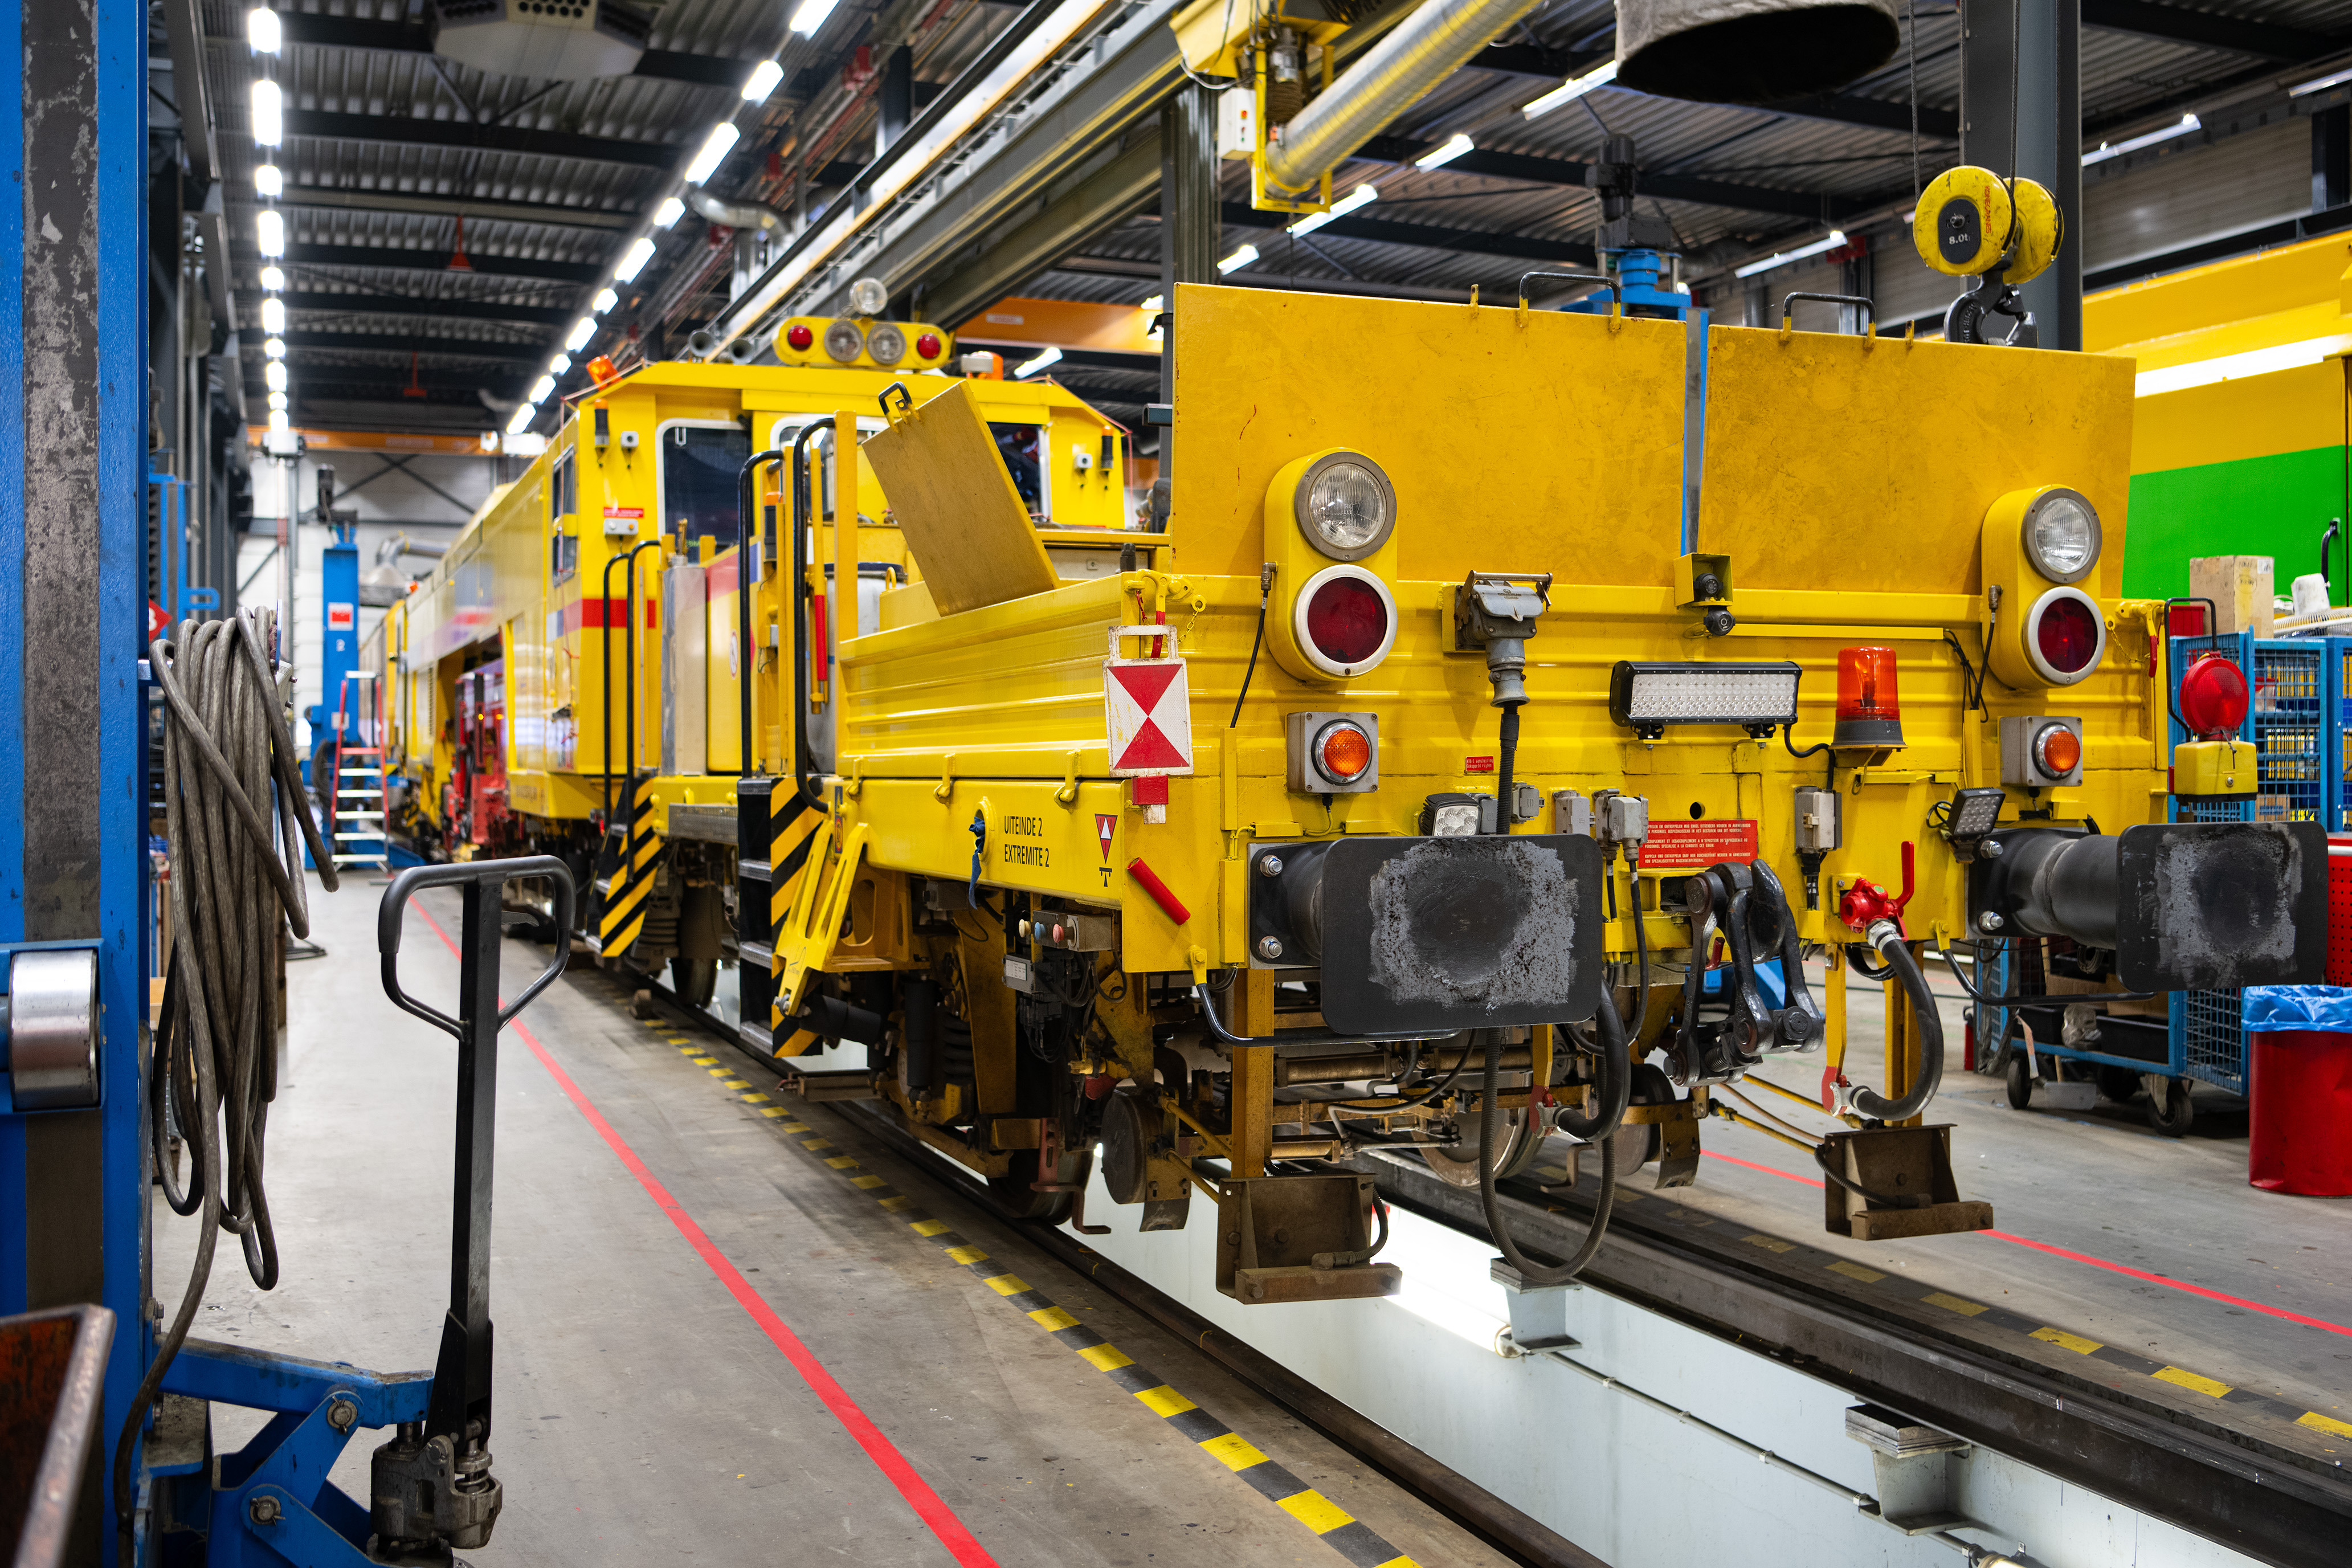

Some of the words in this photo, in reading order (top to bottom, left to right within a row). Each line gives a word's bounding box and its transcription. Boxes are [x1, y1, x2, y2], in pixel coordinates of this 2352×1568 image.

[1949, 233, 1969, 244] 8.0t
[1004, 815, 1036, 836] UITEINDE
[1038, 817, 1042, 836] 2
[1004, 844, 1043, 866] EXTREMITE
[1045, 848, 1050, 867] 2
